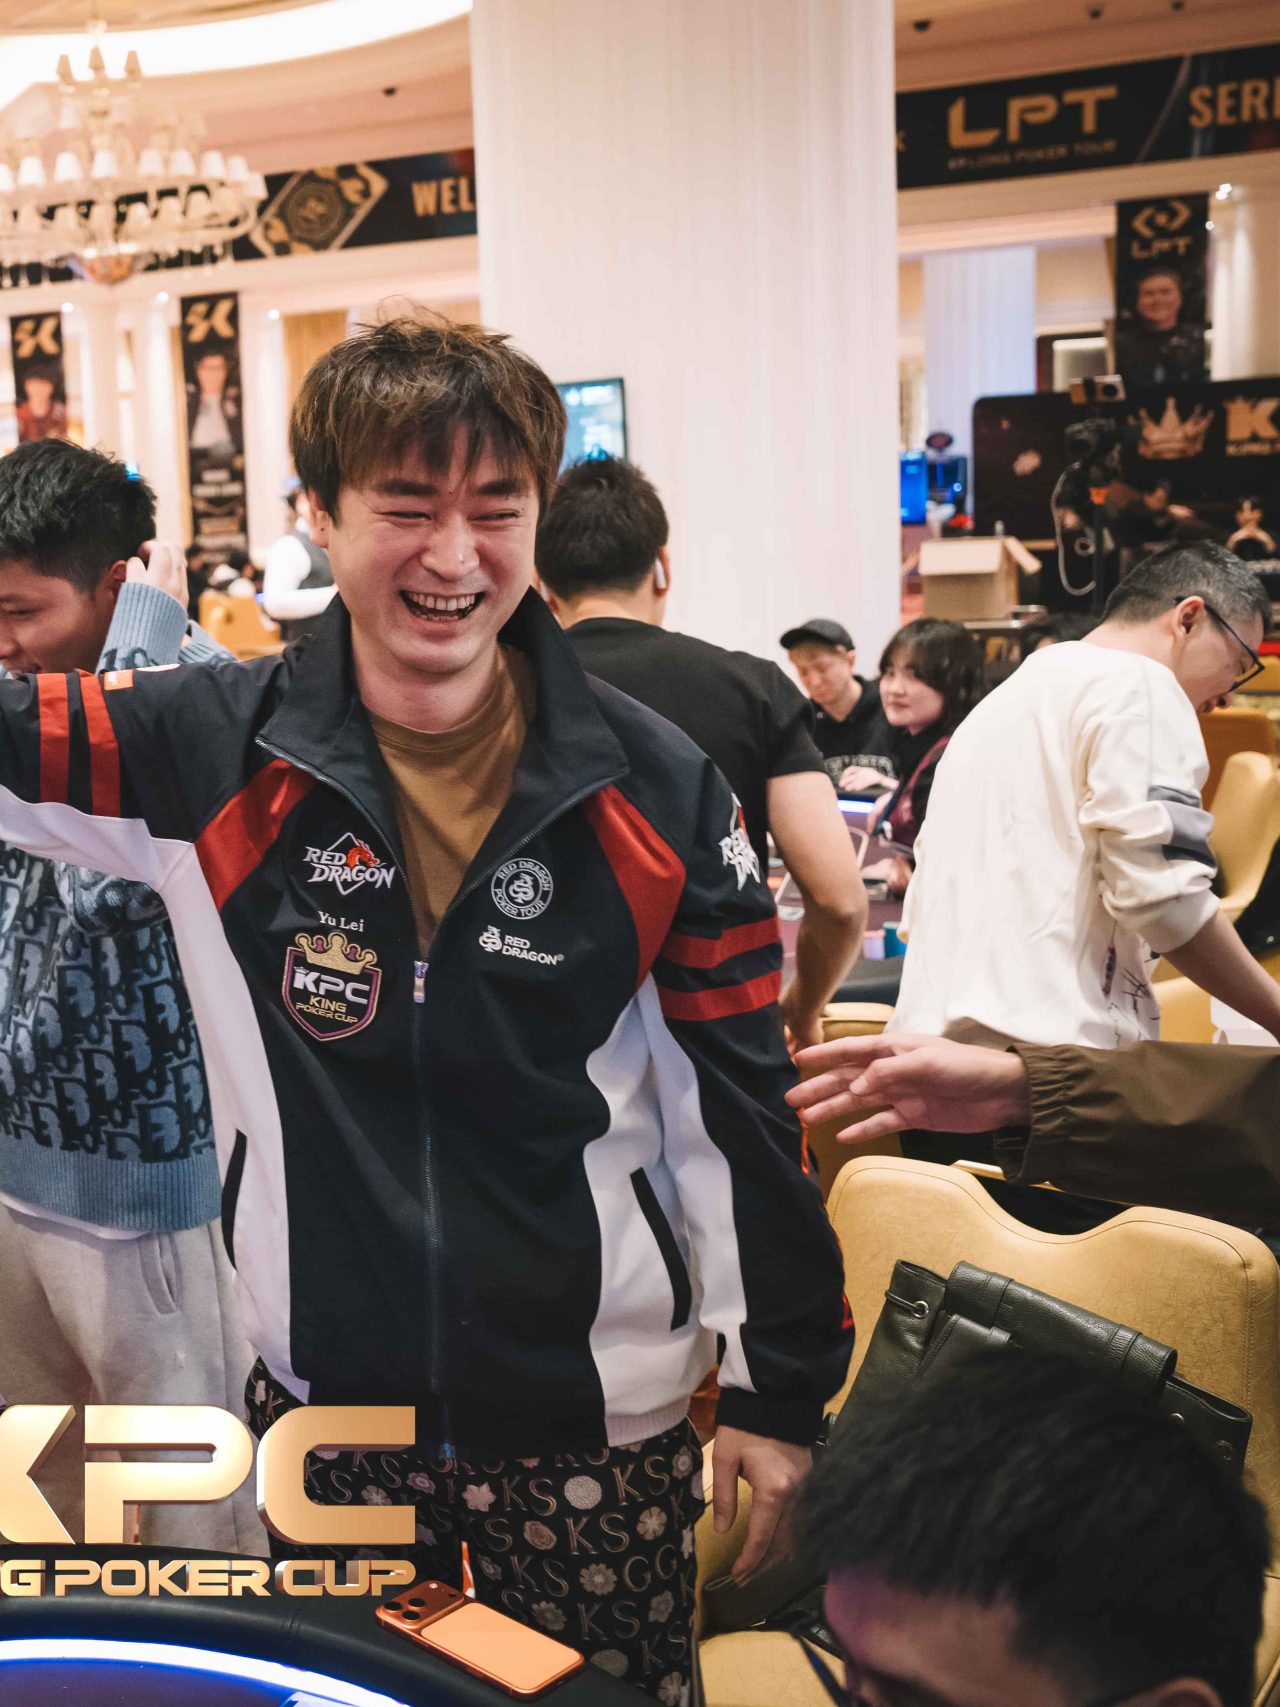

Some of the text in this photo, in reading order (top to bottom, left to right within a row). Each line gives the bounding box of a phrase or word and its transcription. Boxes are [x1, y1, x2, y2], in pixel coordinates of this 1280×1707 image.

[947, 85, 1117, 150] LPT
[412, 177, 476, 217] WEL
[1131, 236, 1192, 258] LPT
[303, 846, 347, 866] RED
[306, 863, 396, 889] DRAGON
[498, 860, 551, 892] RED DRAGON
[494, 888, 546, 917] POKER TOUR
[318, 910, 365, 933] Yu Lei
[504, 935, 531, 950] RED
[293, 966, 371, 1005] KPC
[295, 1002, 359, 1024] POKER CUP
[309, 995, 348, 1014] KING
